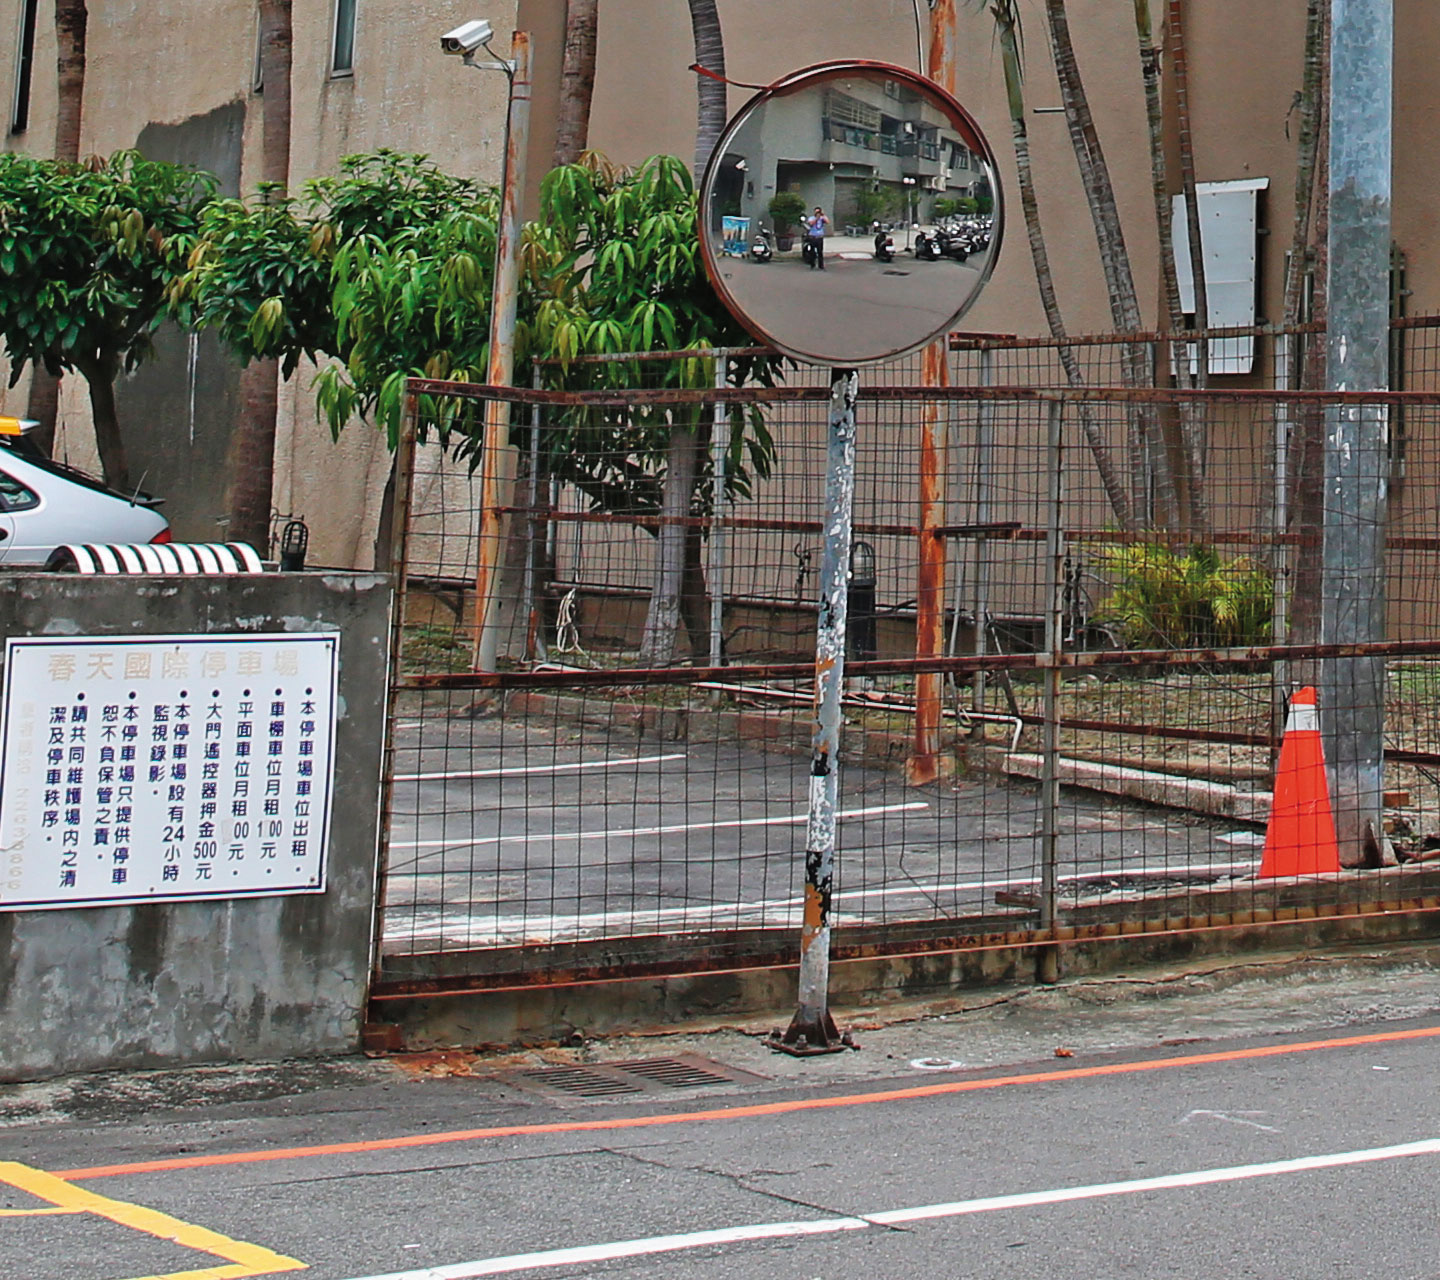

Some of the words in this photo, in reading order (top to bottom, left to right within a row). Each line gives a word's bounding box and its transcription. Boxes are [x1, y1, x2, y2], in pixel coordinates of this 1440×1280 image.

[48, 648, 300, 682] 春天國際停車場
